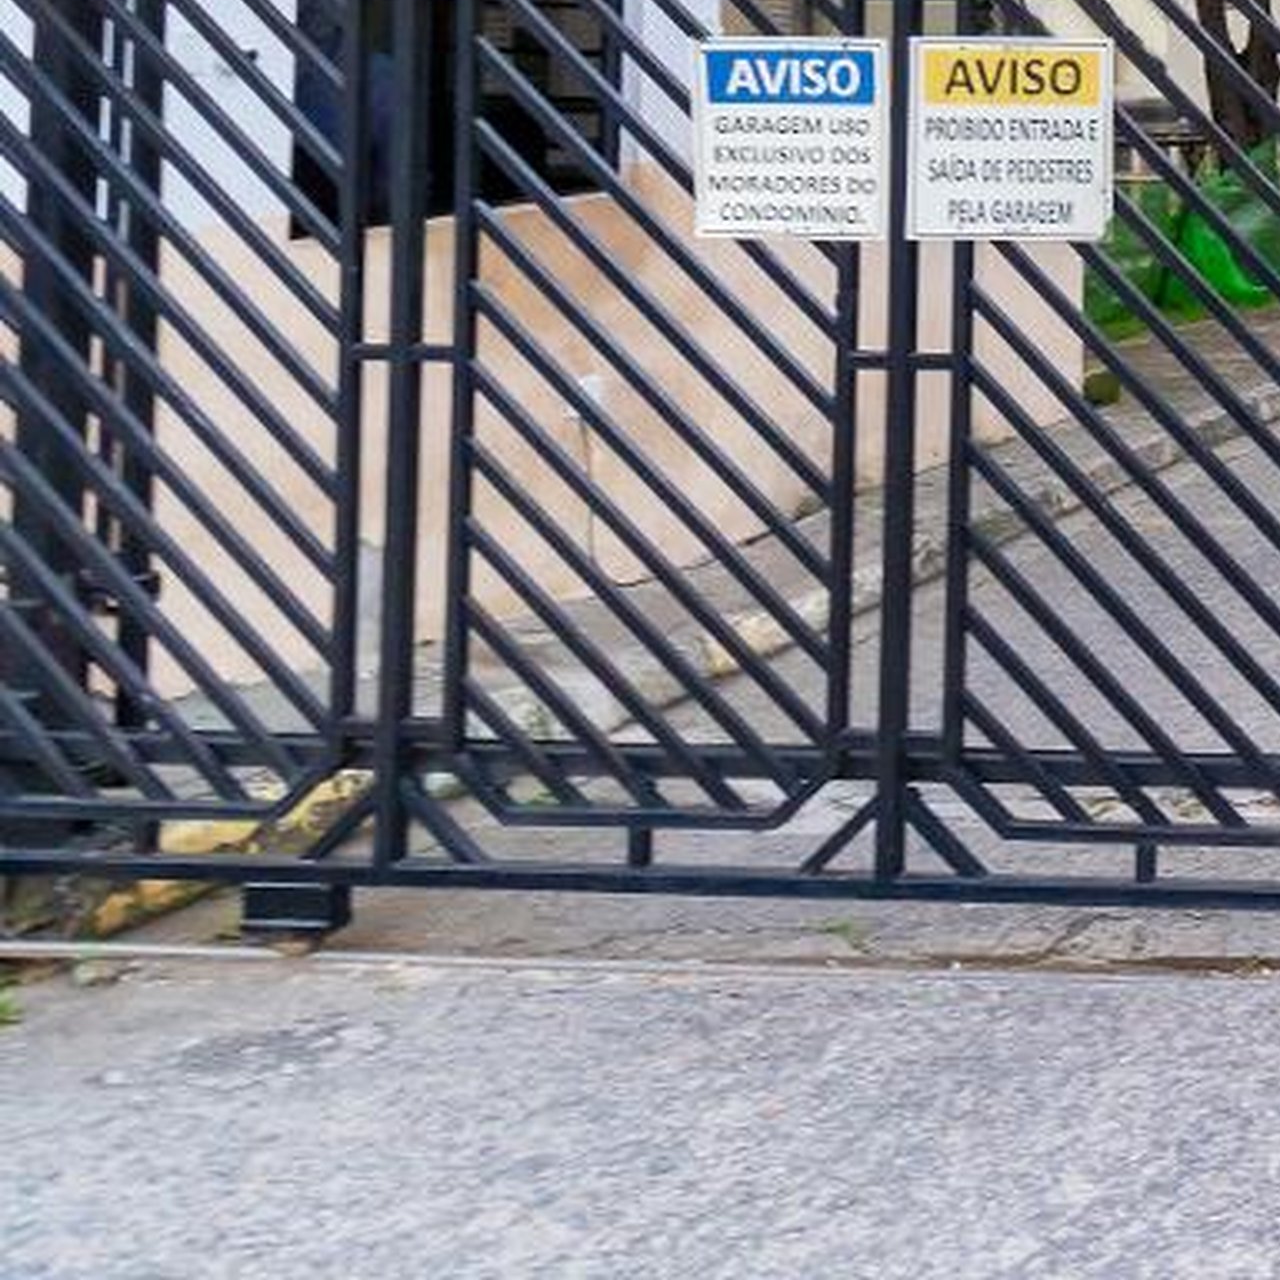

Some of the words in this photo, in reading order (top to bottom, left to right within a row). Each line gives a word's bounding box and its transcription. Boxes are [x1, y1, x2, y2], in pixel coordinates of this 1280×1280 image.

[726, 58, 861, 96] AVISO
[945, 58, 1082, 95] AVISO
[715, 116, 823, 135] GARAGEM
[829, 117, 870, 136] USO
[925, 117, 1004, 141] PROIBIDO
[1008, 118, 1085, 141] ENTRADA
[1089, 118, 1098, 141] E
[714, 146, 825, 165] EXCLUSIVO
[831, 146, 871, 165] DOS
[981, 159, 1003, 182] DE
[1007, 159, 1094, 184] PEDESTRES
[707, 175, 842, 195] MORADORES
[847, 176, 877, 195] DO
[949, 199, 986, 223] PELA
[991, 199, 1073, 224] GARAGEM
